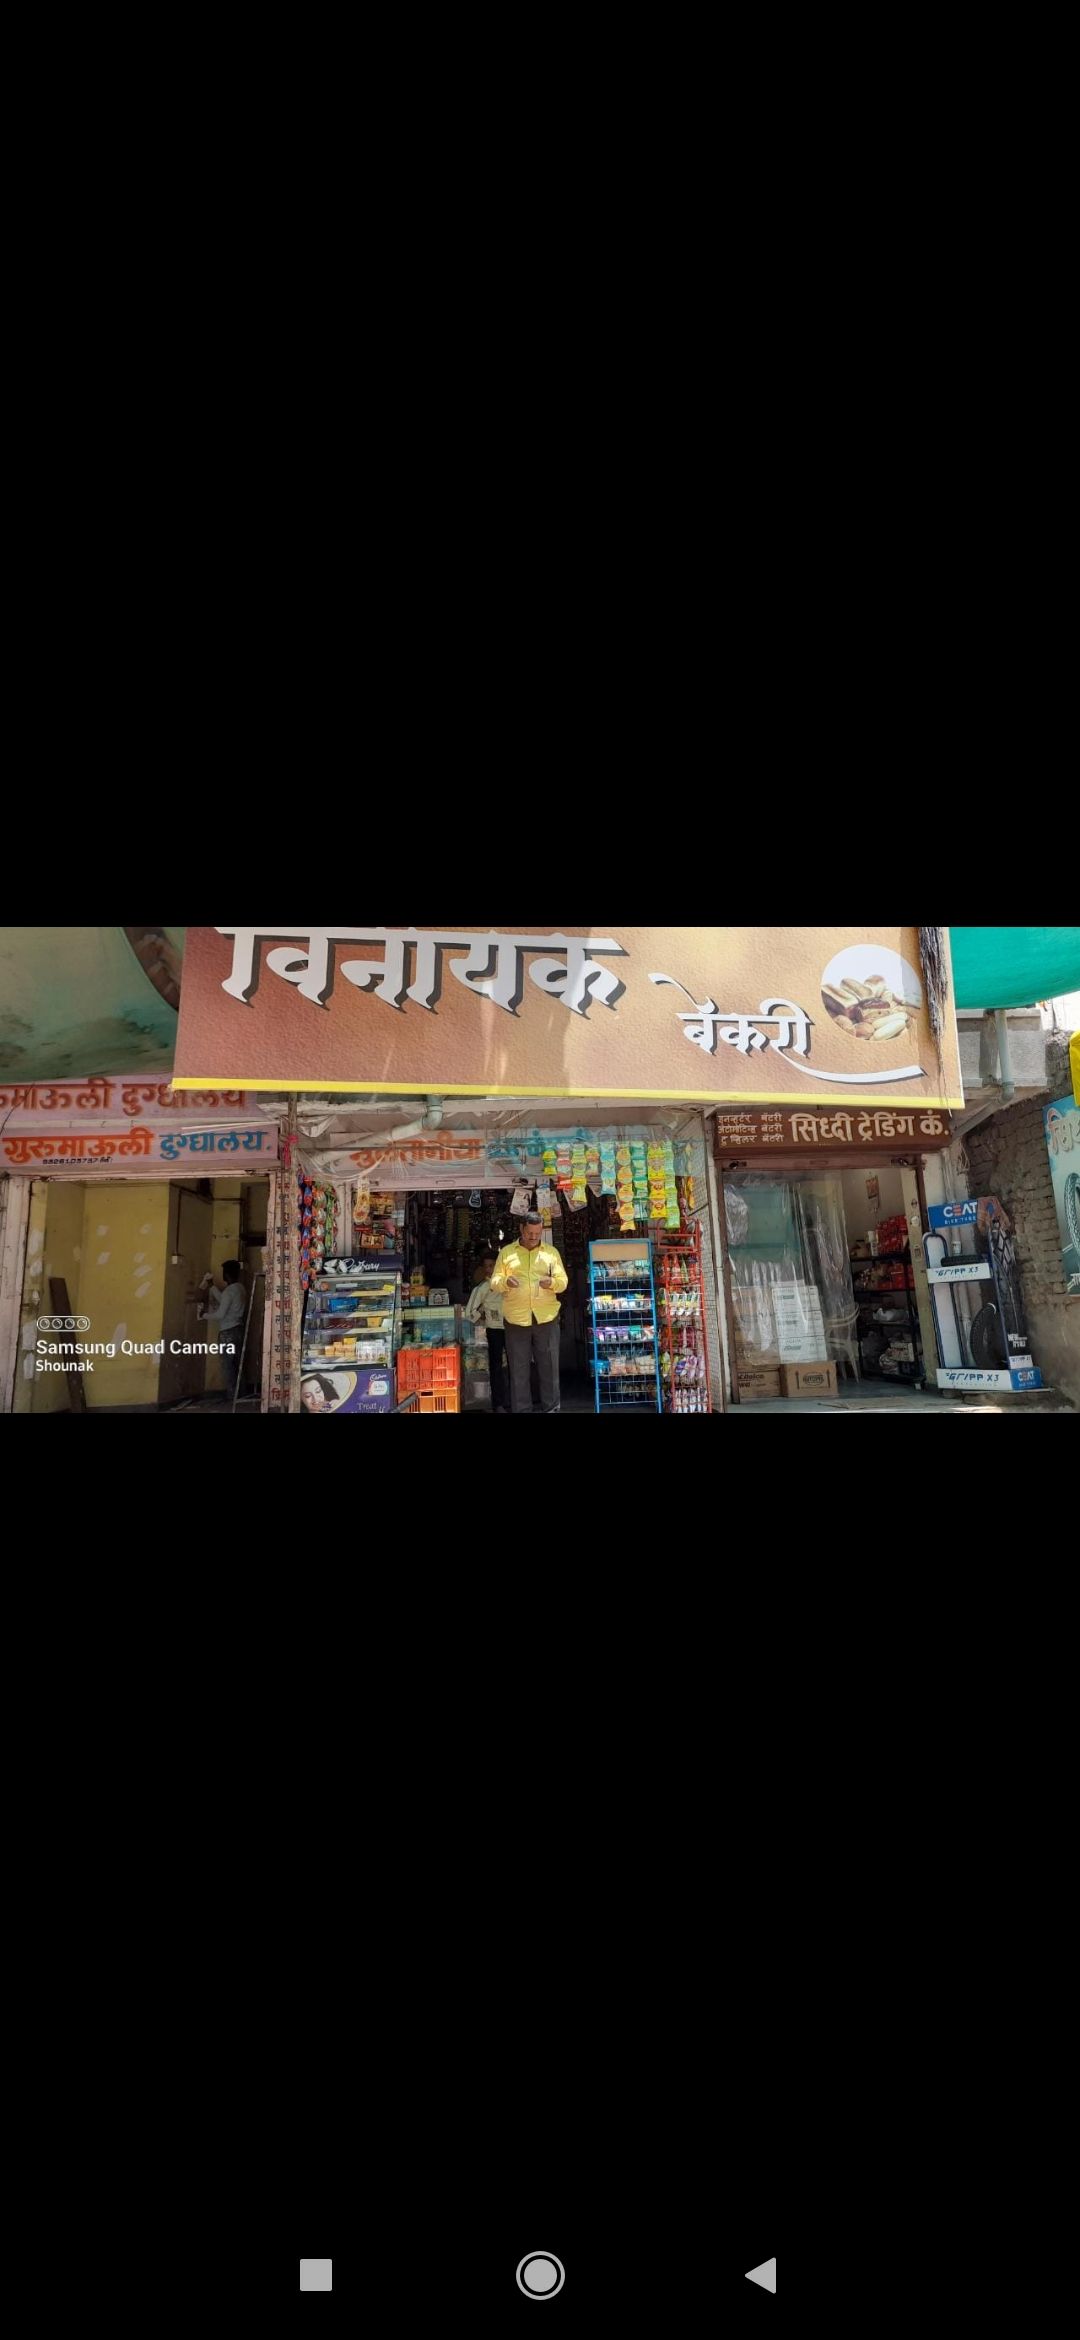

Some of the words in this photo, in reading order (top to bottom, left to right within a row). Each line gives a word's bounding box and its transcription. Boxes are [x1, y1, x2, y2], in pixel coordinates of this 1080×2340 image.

[213, 927, 630, 1019] विनायक
[857, 1111, 914, 1141] ट्रेडिंग
[2, 1127, 154, 1164] गुरुमाऊली
[943, 1201, 977, 1218] CEAT
